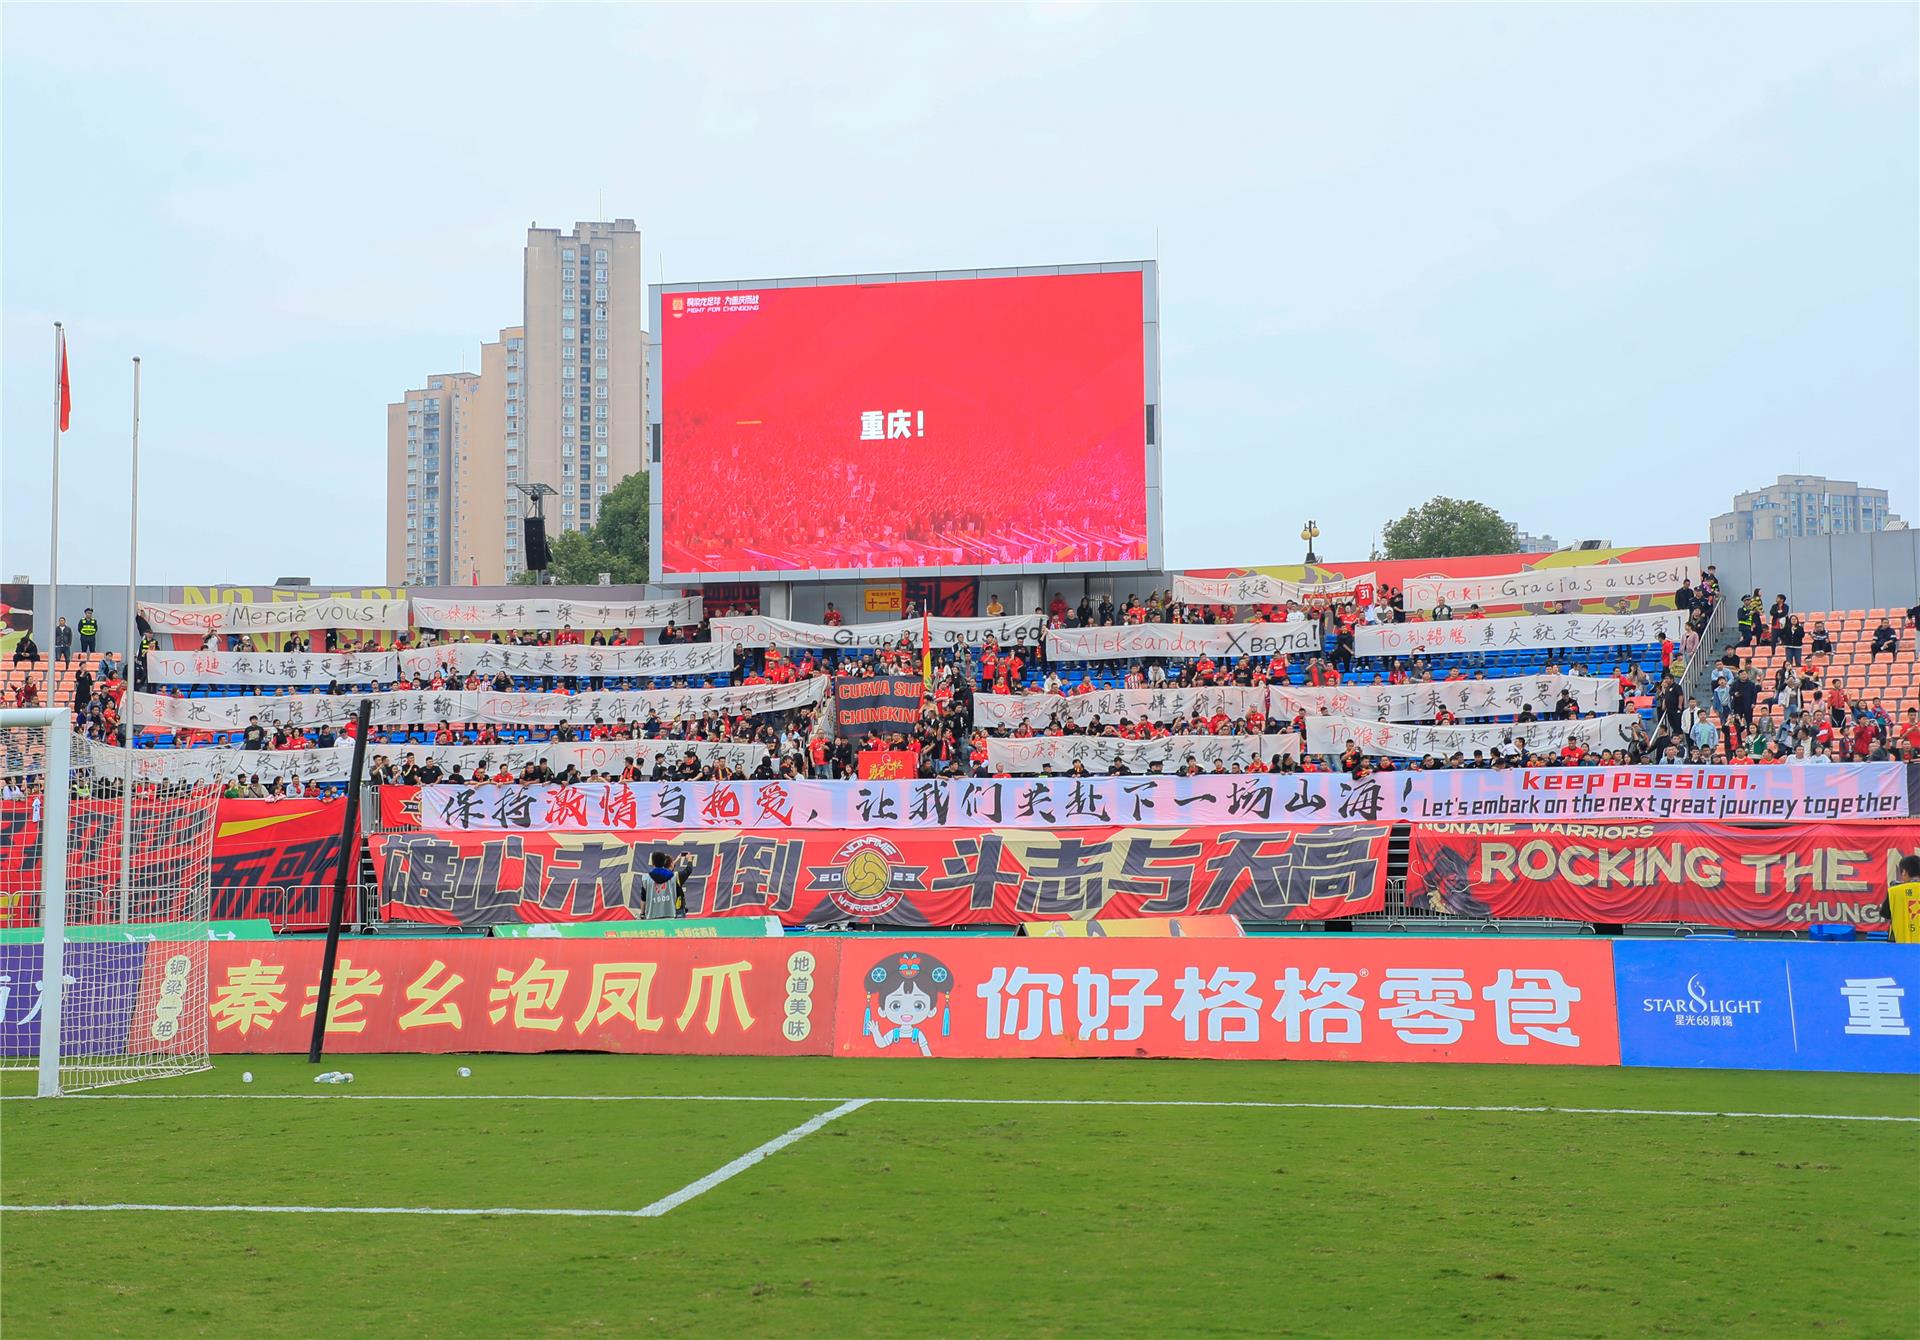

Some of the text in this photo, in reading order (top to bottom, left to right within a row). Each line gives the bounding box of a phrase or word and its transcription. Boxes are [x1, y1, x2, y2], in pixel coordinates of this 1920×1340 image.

[860, 409, 925, 440] 重庆！
[1360, 589, 1370, 600] 31
[1502, 575, 1593, 597] Gracias
[867, 597, 900, 609] 十一区
[839, 680, 890, 699] CURVA
[1522, 770, 1757, 796] keep passion.
[1472, 795, 1539, 816] embark
[1544, 799, 1567, 815] on
[1572, 794, 1604, 814] the
[1609, 796, 1656, 814] next
[1660, 795, 1719, 818] great
[1720, 797, 1797, 820] journey
[1803, 794, 1902, 818] together
[1531, 823, 1654, 839] WARRIORS
[839, 837, 897, 857] NONAME
[932, 823, 1393, 913] 斗志与天高
[1480, 839, 1722, 889] ROCKING
[1741, 848, 1869, 893] THE
[1786, 902, 1886, 923] CHUNG
[155, 959, 187, 1037] 铜梁一绝
[209, 958, 756, 1036] 秦老幺泡凤爪
[787, 955, 811, 1037] 地道美味
[1840, 977, 1911, 1036] 重
